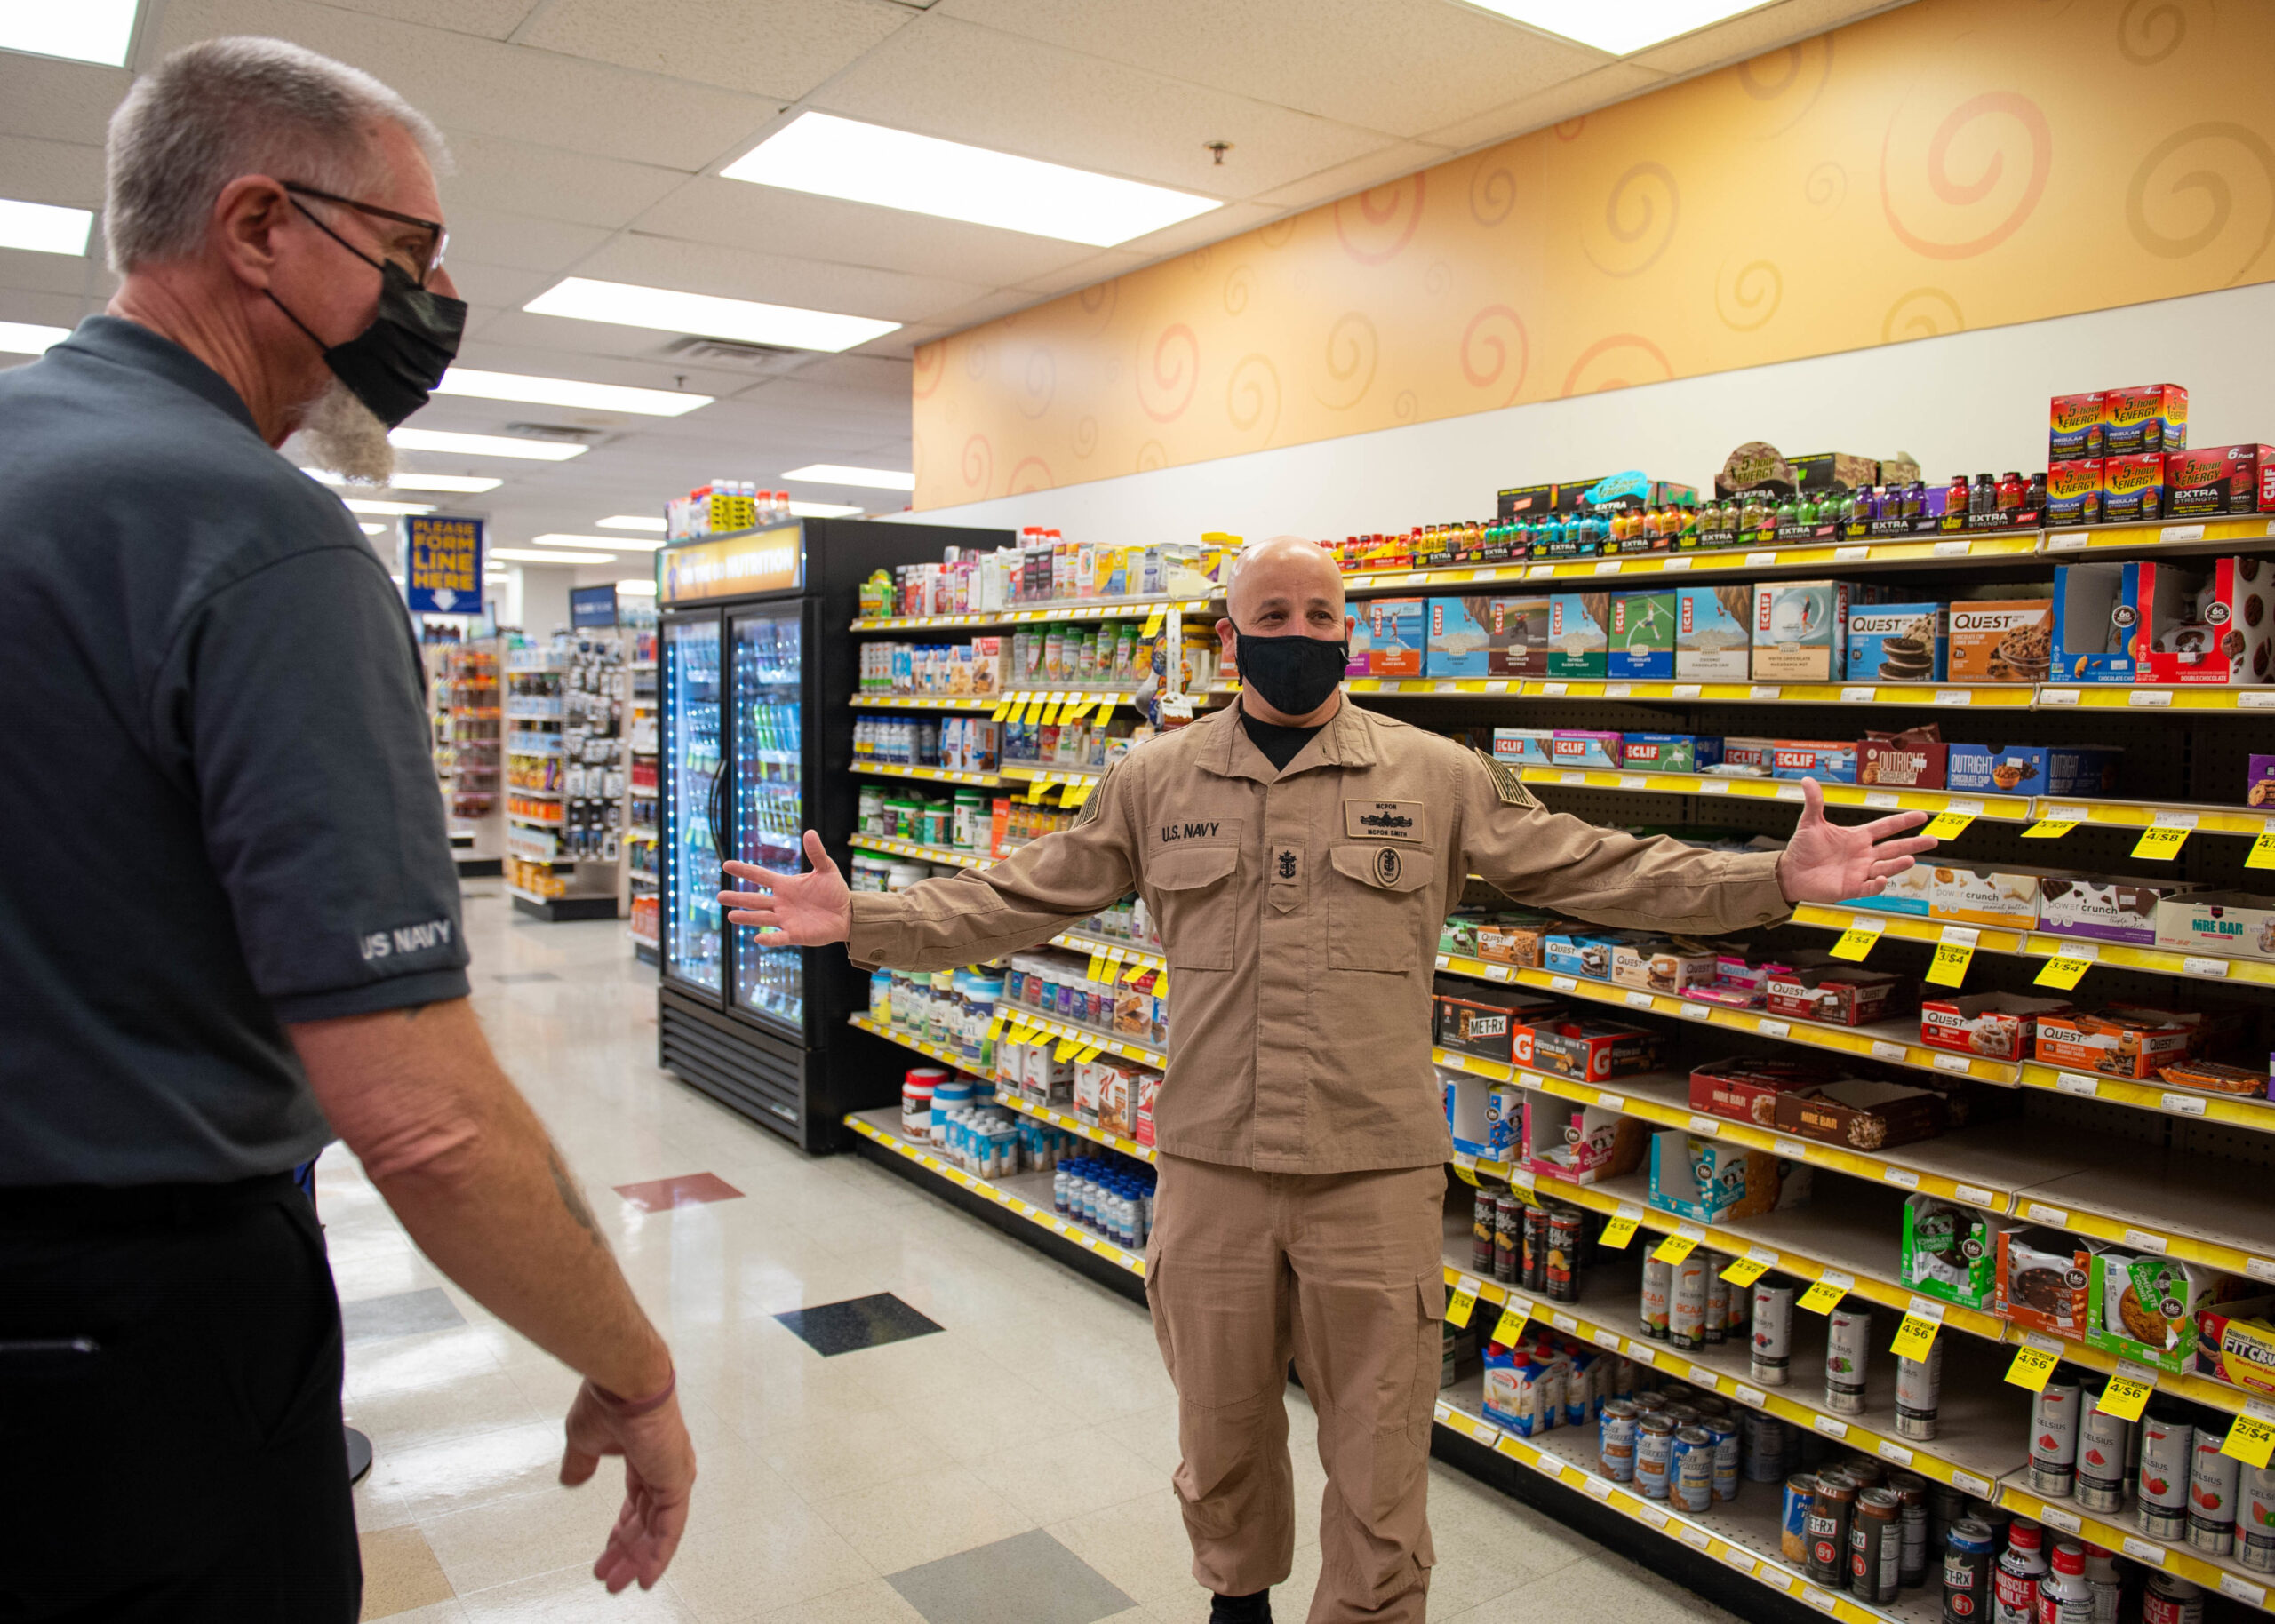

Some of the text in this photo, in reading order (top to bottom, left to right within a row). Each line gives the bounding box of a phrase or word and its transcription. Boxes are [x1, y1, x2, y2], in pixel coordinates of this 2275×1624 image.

[2068, 404, 2101, 418] 5-hour
[2125, 397, 2159, 411] 5-hour
[2064, 413, 2100, 428] ENERGY
[2120, 406, 2158, 422] ENERGY
[2227, 449, 2238, 459] 6
[1741, 455, 1775, 470] 5-hour
[2185, 460, 2223, 474] 5-hour
[1737, 467, 1776, 484] ENERGY
[2064, 470, 2098, 483] 5-hour
[2122, 465, 2157, 479] 5-hour
[2180, 470, 2222, 486] ENERGY
[2061, 480, 2096, 495] ENERGY
[2118, 475, 2155, 490] ENERGY
[2263, 468, 2275, 500] CLIF
[2175, 489, 2218, 498] EXTRA
[1872, 521, 1908, 529] EXTRA
[1968, 513, 2008, 522] EXTRA
[413, 519, 475, 534] PLEASE
[1778, 526, 1810, 535] EXTRA
[413, 534, 475, 551] FORM
[1701, 532, 1733, 541] EXTRA
[1485, 548, 1509, 557] EXTRA
[1550, 542, 1577, 552] EXTRA
[412, 550, 475, 572] LINE
[725, 545, 794, 578] NUTRITION
[412, 571, 476, 591] HERE
[1616, 601, 1625, 626] CLIF
[1683, 598, 1693, 624] CLIF
[1760, 594, 1771, 621] CLIF
[1553, 604, 1563, 627] CLIF
[1955, 614, 2012, 630] QUEST
[1852, 617, 1902, 632] QUEST
[1501, 739, 1522, 752] CLIF
[1561, 741, 1585, 754] CLIF
[1633, 744, 1658, 759] CLIF
[1734, 750, 1761, 764] CLIF
[1784, 753, 1814, 768] CLIF
[1880, 751, 1926, 772] OUTRIGHT
[1952, 754, 1994, 775] OUTRIGHT
[1162, 822, 1219, 843] U.S. NAVY
[2146, 830, 2180, 842] 4/$8
[1966, 891, 1999, 902] crunch
[2081, 904, 2118, 915] crunch
[2192, 919, 2243, 935] MRE BAR
[360, 919, 451, 959] US NAVY
[1550, 943, 1576, 955] QUEST
[1617, 955, 1643, 967] QUEST
[1937, 951, 1964, 964] 3/$4
[1686, 963, 1711, 975] QUEST
[1721, 965, 1749, 977] QUEST
[2049, 960, 2080, 973] 3/$4
[1773, 983, 1805, 997] QUEST
[1928, 1011, 1965, 1028] QUEST
[2044, 1027, 2083, 1043] QUEST
[1513, 1034, 1532, 1061] G
[1534, 1039, 1567, 1055] PROTEIN BAR
[2150, 1038, 2173, 1051] QUEST
[1593, 1047, 1610, 1075] G
[1712, 1089, 1746, 1107] MRE BAR
[1801, 1111, 1837, 1130] MRE BAR
[1812, 1286, 1838, 1299] 4/$6
[2134, 1274, 2148, 1302] COOKIE
[2136, 1265, 2159, 1309] COMPLETE
[1676, 1302, 1703, 1315] BCAA
[1902, 1324, 1928, 1340] 4/$6
[2227, 1328, 2274, 1349] ROBERT IRVINE'S
[2018, 1354, 2047, 1369] 4/$6
[2110, 1383, 2141, 1399] 4/$6
[2037, 1418, 2066, 1431] CELSIUS
[2084, 1431, 2114, 1446] CELSIUS
[2235, 1423, 2270, 1443] 2/$4
[2140, 1455, 2169, 1471] CELSIUS
[2191, 1469, 2222, 1485] CELSIUS
[1808, 1519, 1836, 1534] ET-RX
[1818, 1545, 1832, 1559] 51
[1944, 1571, 1971, 1587] ET-RX
[2000, 1587, 2022, 1606] MILK
[1954, 1598, 1969, 1612] 51
